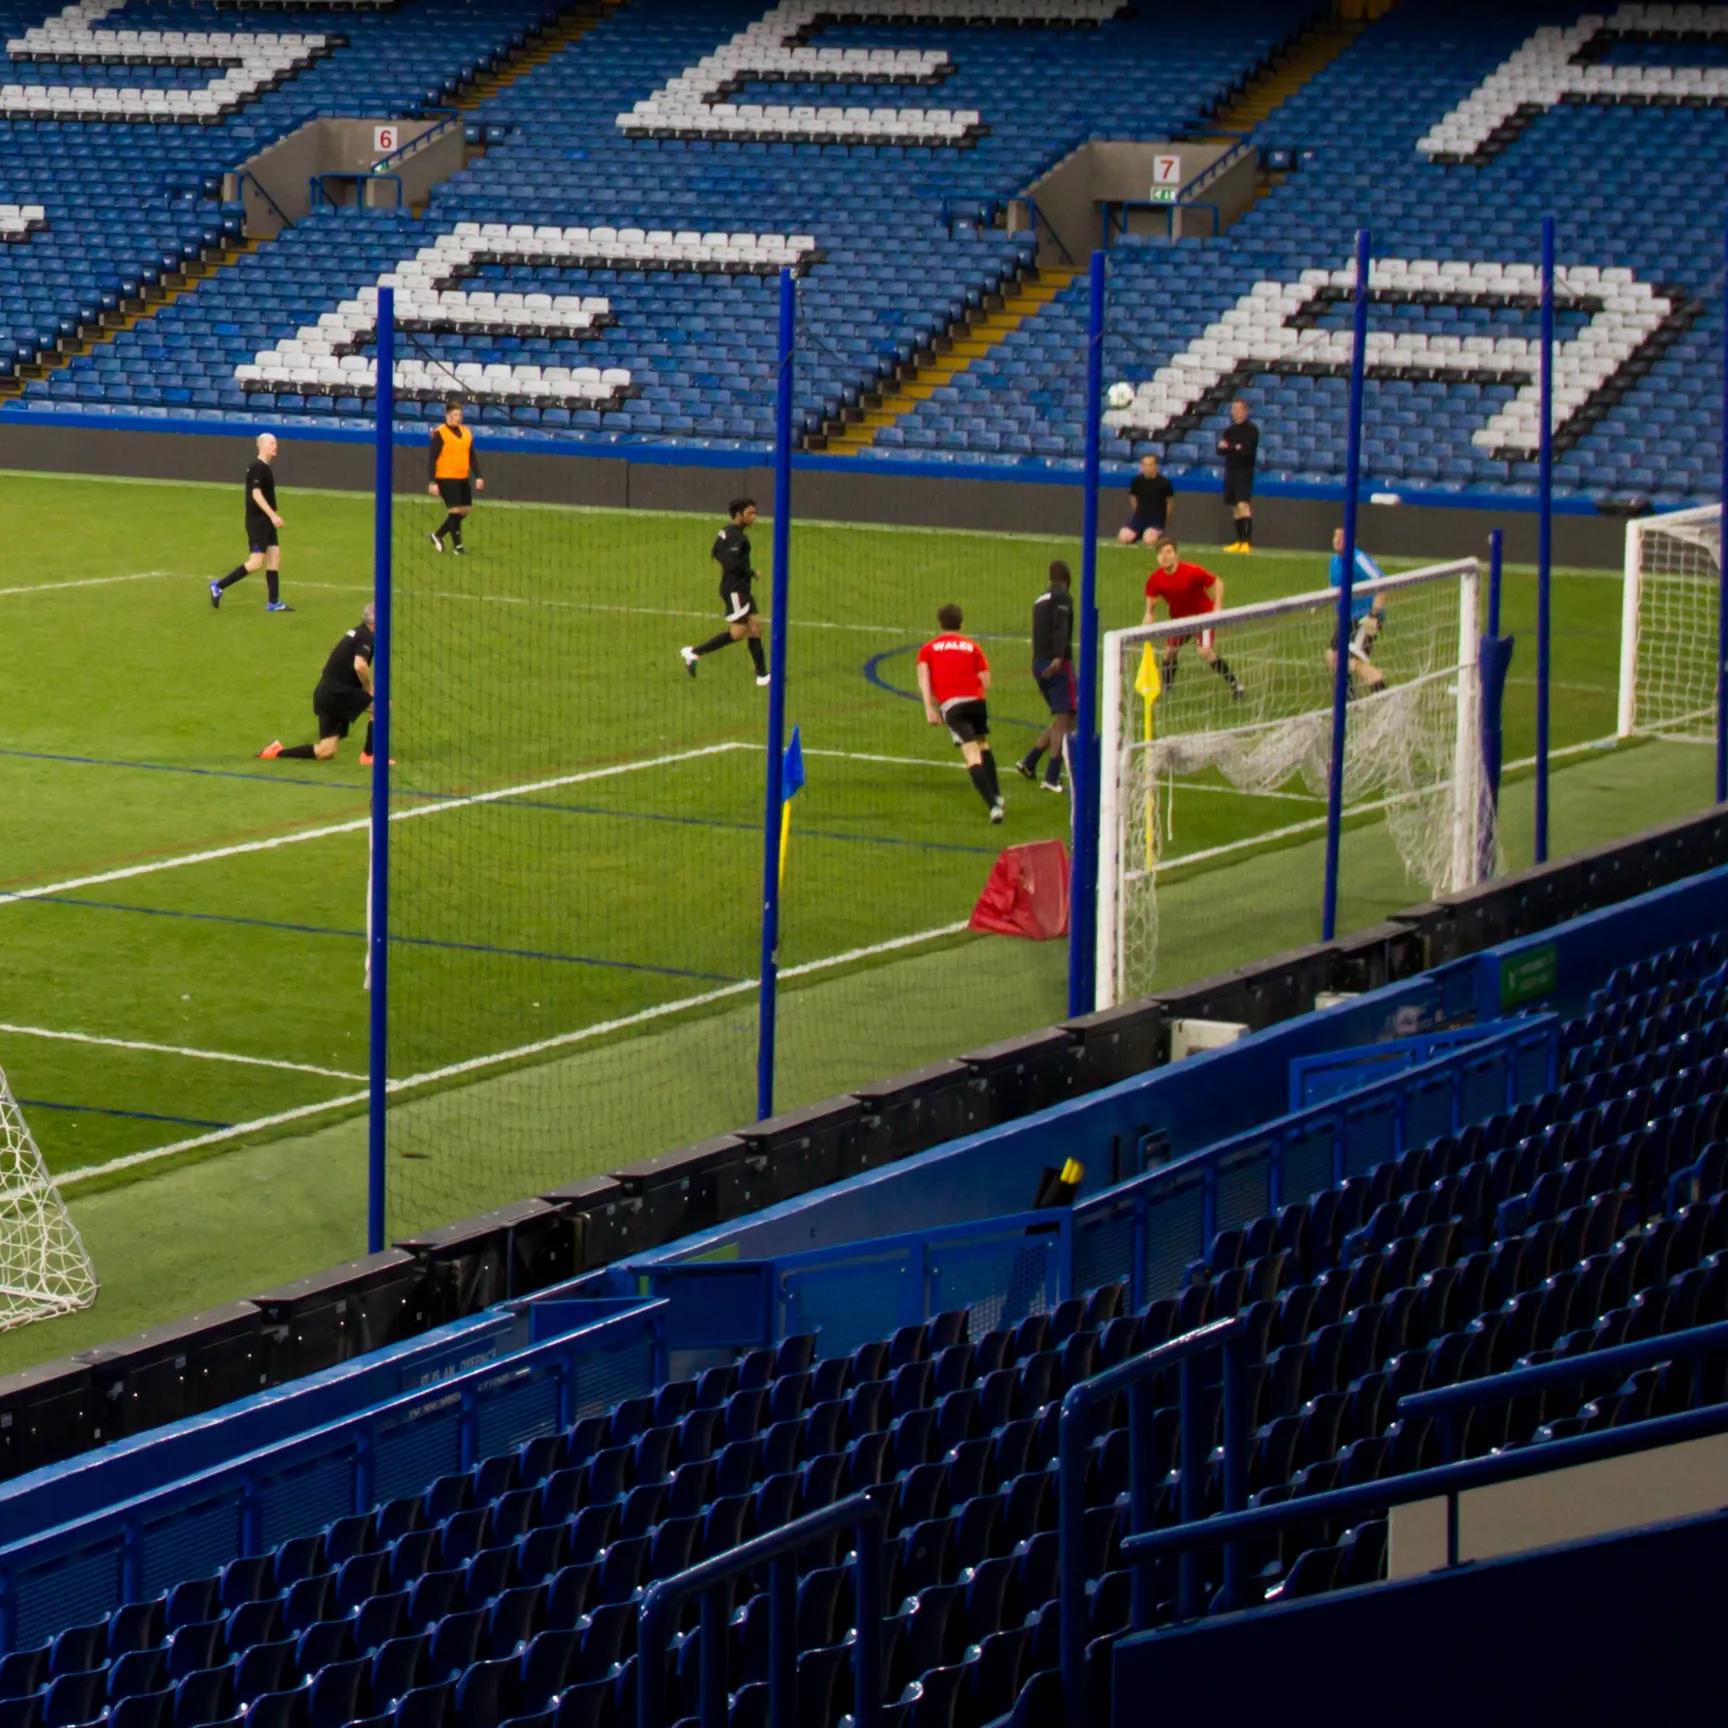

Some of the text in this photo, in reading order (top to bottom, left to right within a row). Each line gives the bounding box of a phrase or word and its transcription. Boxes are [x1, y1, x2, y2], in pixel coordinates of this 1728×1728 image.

[380, 130, 392, 148] 6
[1161, 160, 1173, 180] 7
[932, 640, 974, 653] WALES
